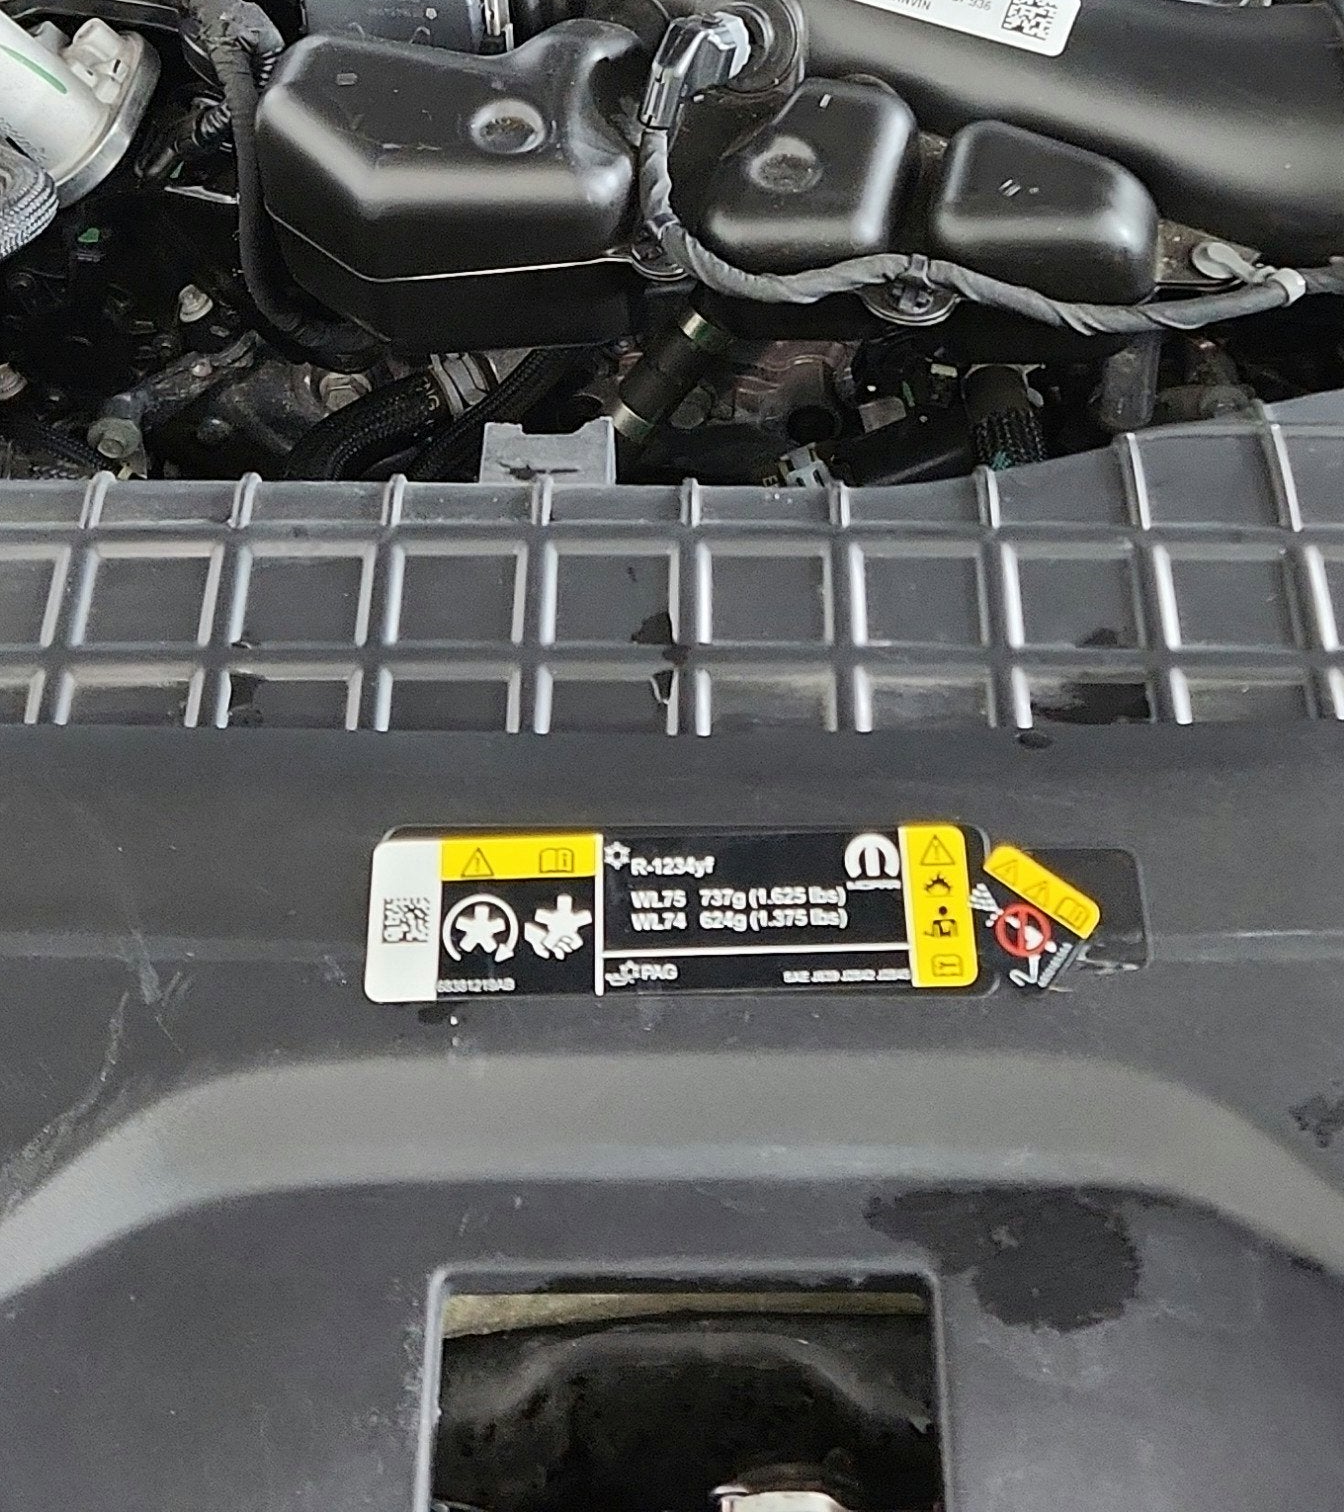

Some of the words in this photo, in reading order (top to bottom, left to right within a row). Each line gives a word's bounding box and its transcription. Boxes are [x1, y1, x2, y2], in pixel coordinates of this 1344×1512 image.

[630, 855, 716, 878] R-1234yf
[630, 889, 687, 909] WL75
[699, 888, 747, 910] 737g
[748, 886, 807, 909] (1.625
[808, 885, 847, 907] lbs)
[630, 911, 687, 931] WL74
[699, 910, 748, 932] 624g
[748, 909, 808, 931] (1.375
[809, 907, 849, 929] lbs)
[641, 963, 679, 981] PAG
